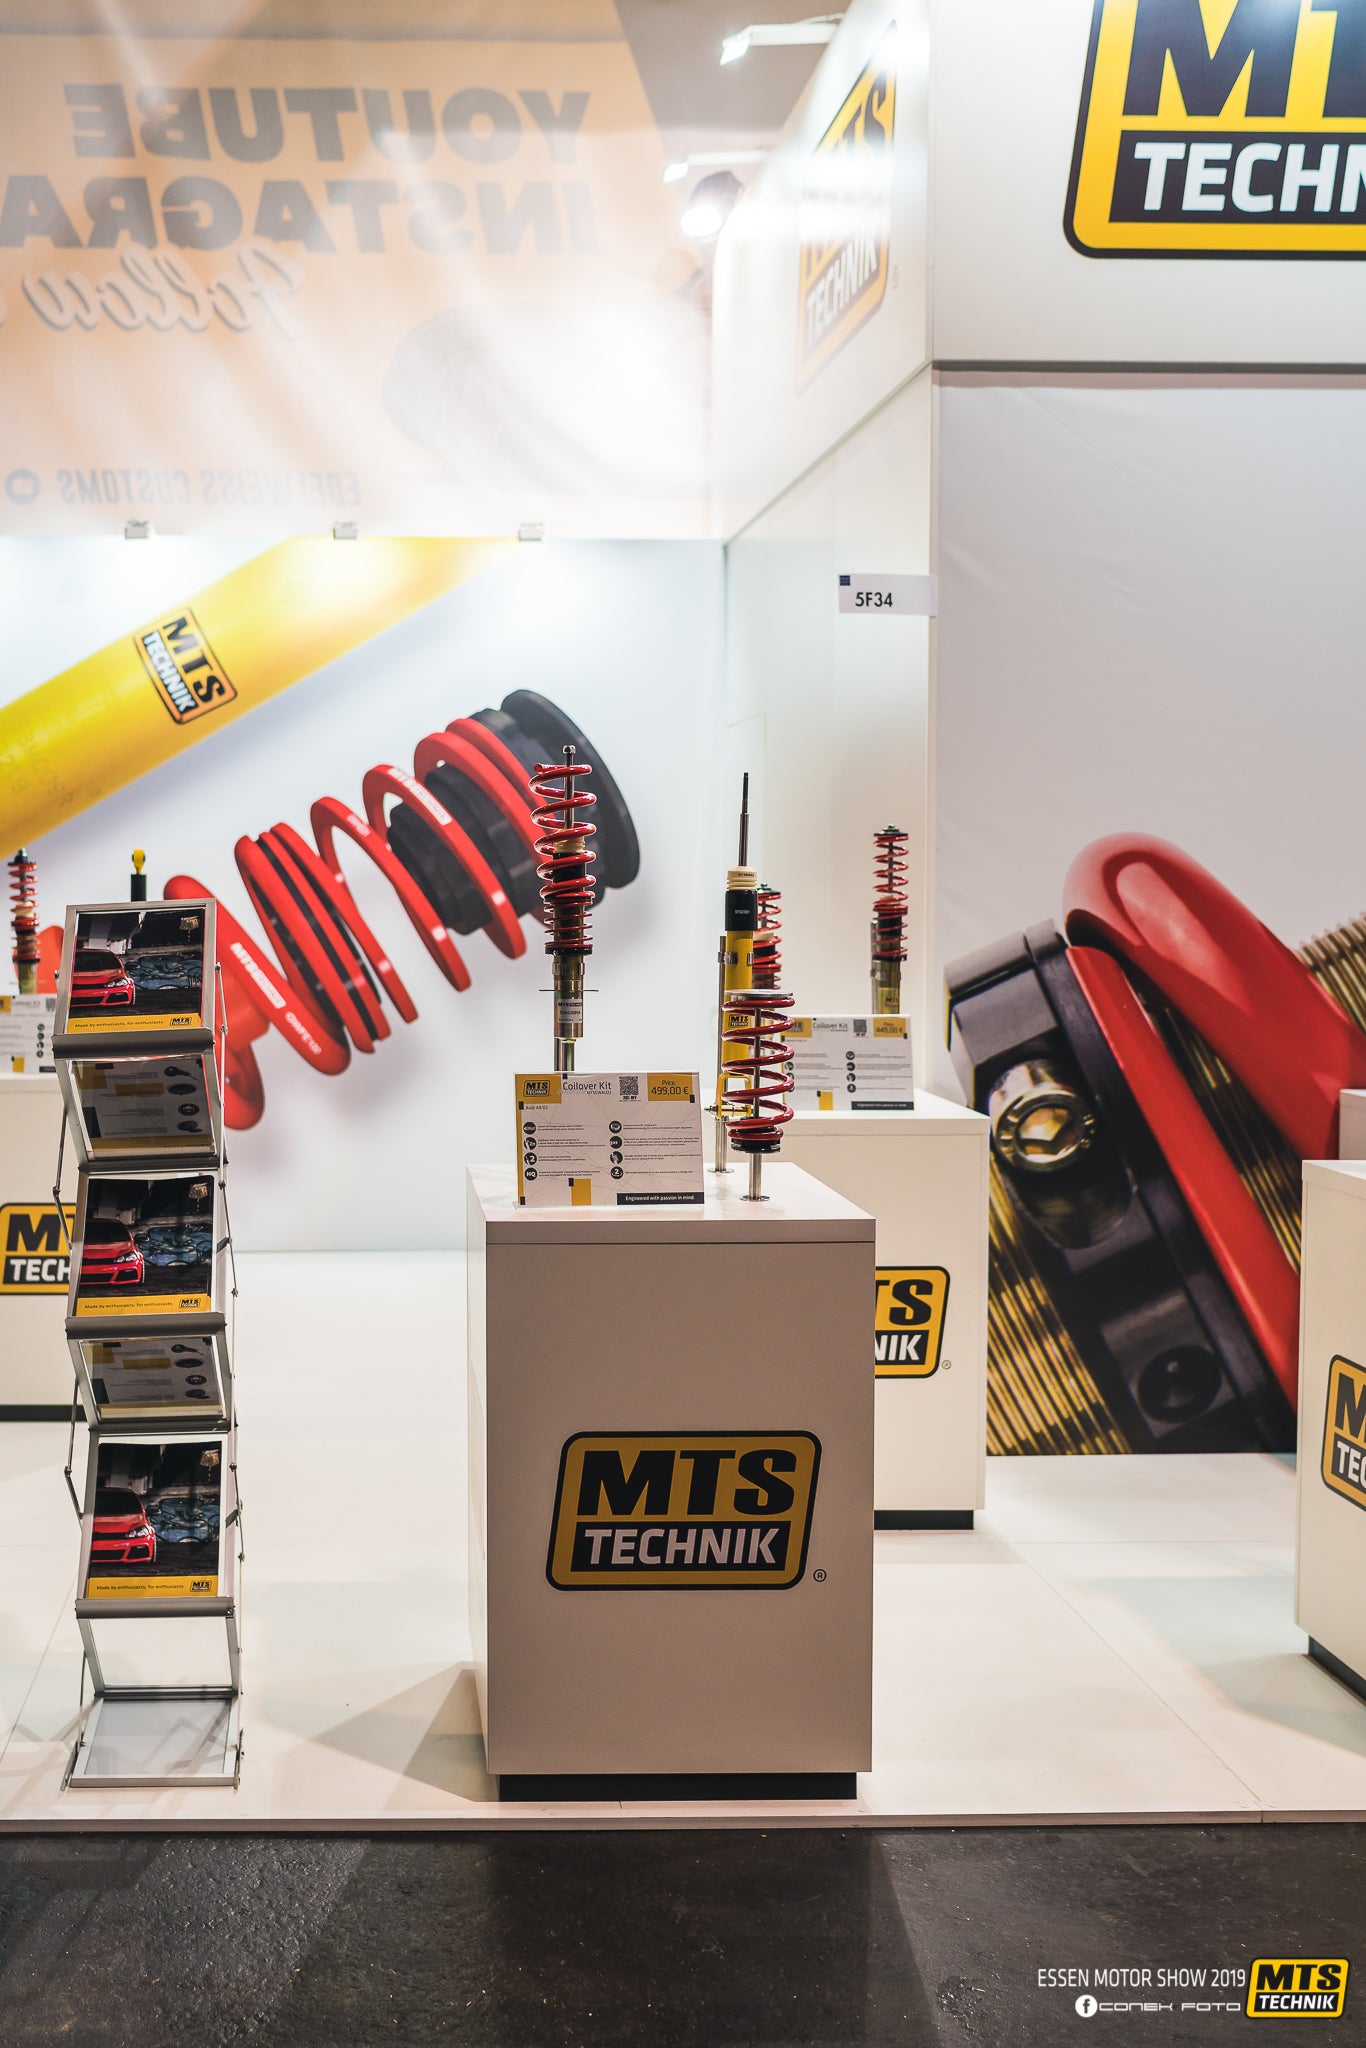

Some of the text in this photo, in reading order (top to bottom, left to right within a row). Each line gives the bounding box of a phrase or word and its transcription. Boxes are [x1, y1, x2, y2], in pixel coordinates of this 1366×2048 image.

[855, 592, 893, 607] 5F34
[143, 630, 197, 713] TECHNIK
[162, 617, 225, 703] MTS
[526, 1082, 548, 1090] MTS
[562, 1082, 612, 1090] Coilover Kit
[651, 1086, 688, 1096] 499,00 €
[576, 1449, 797, 1516] MTS
[584, 1528, 780, 1565] TECHNIK
